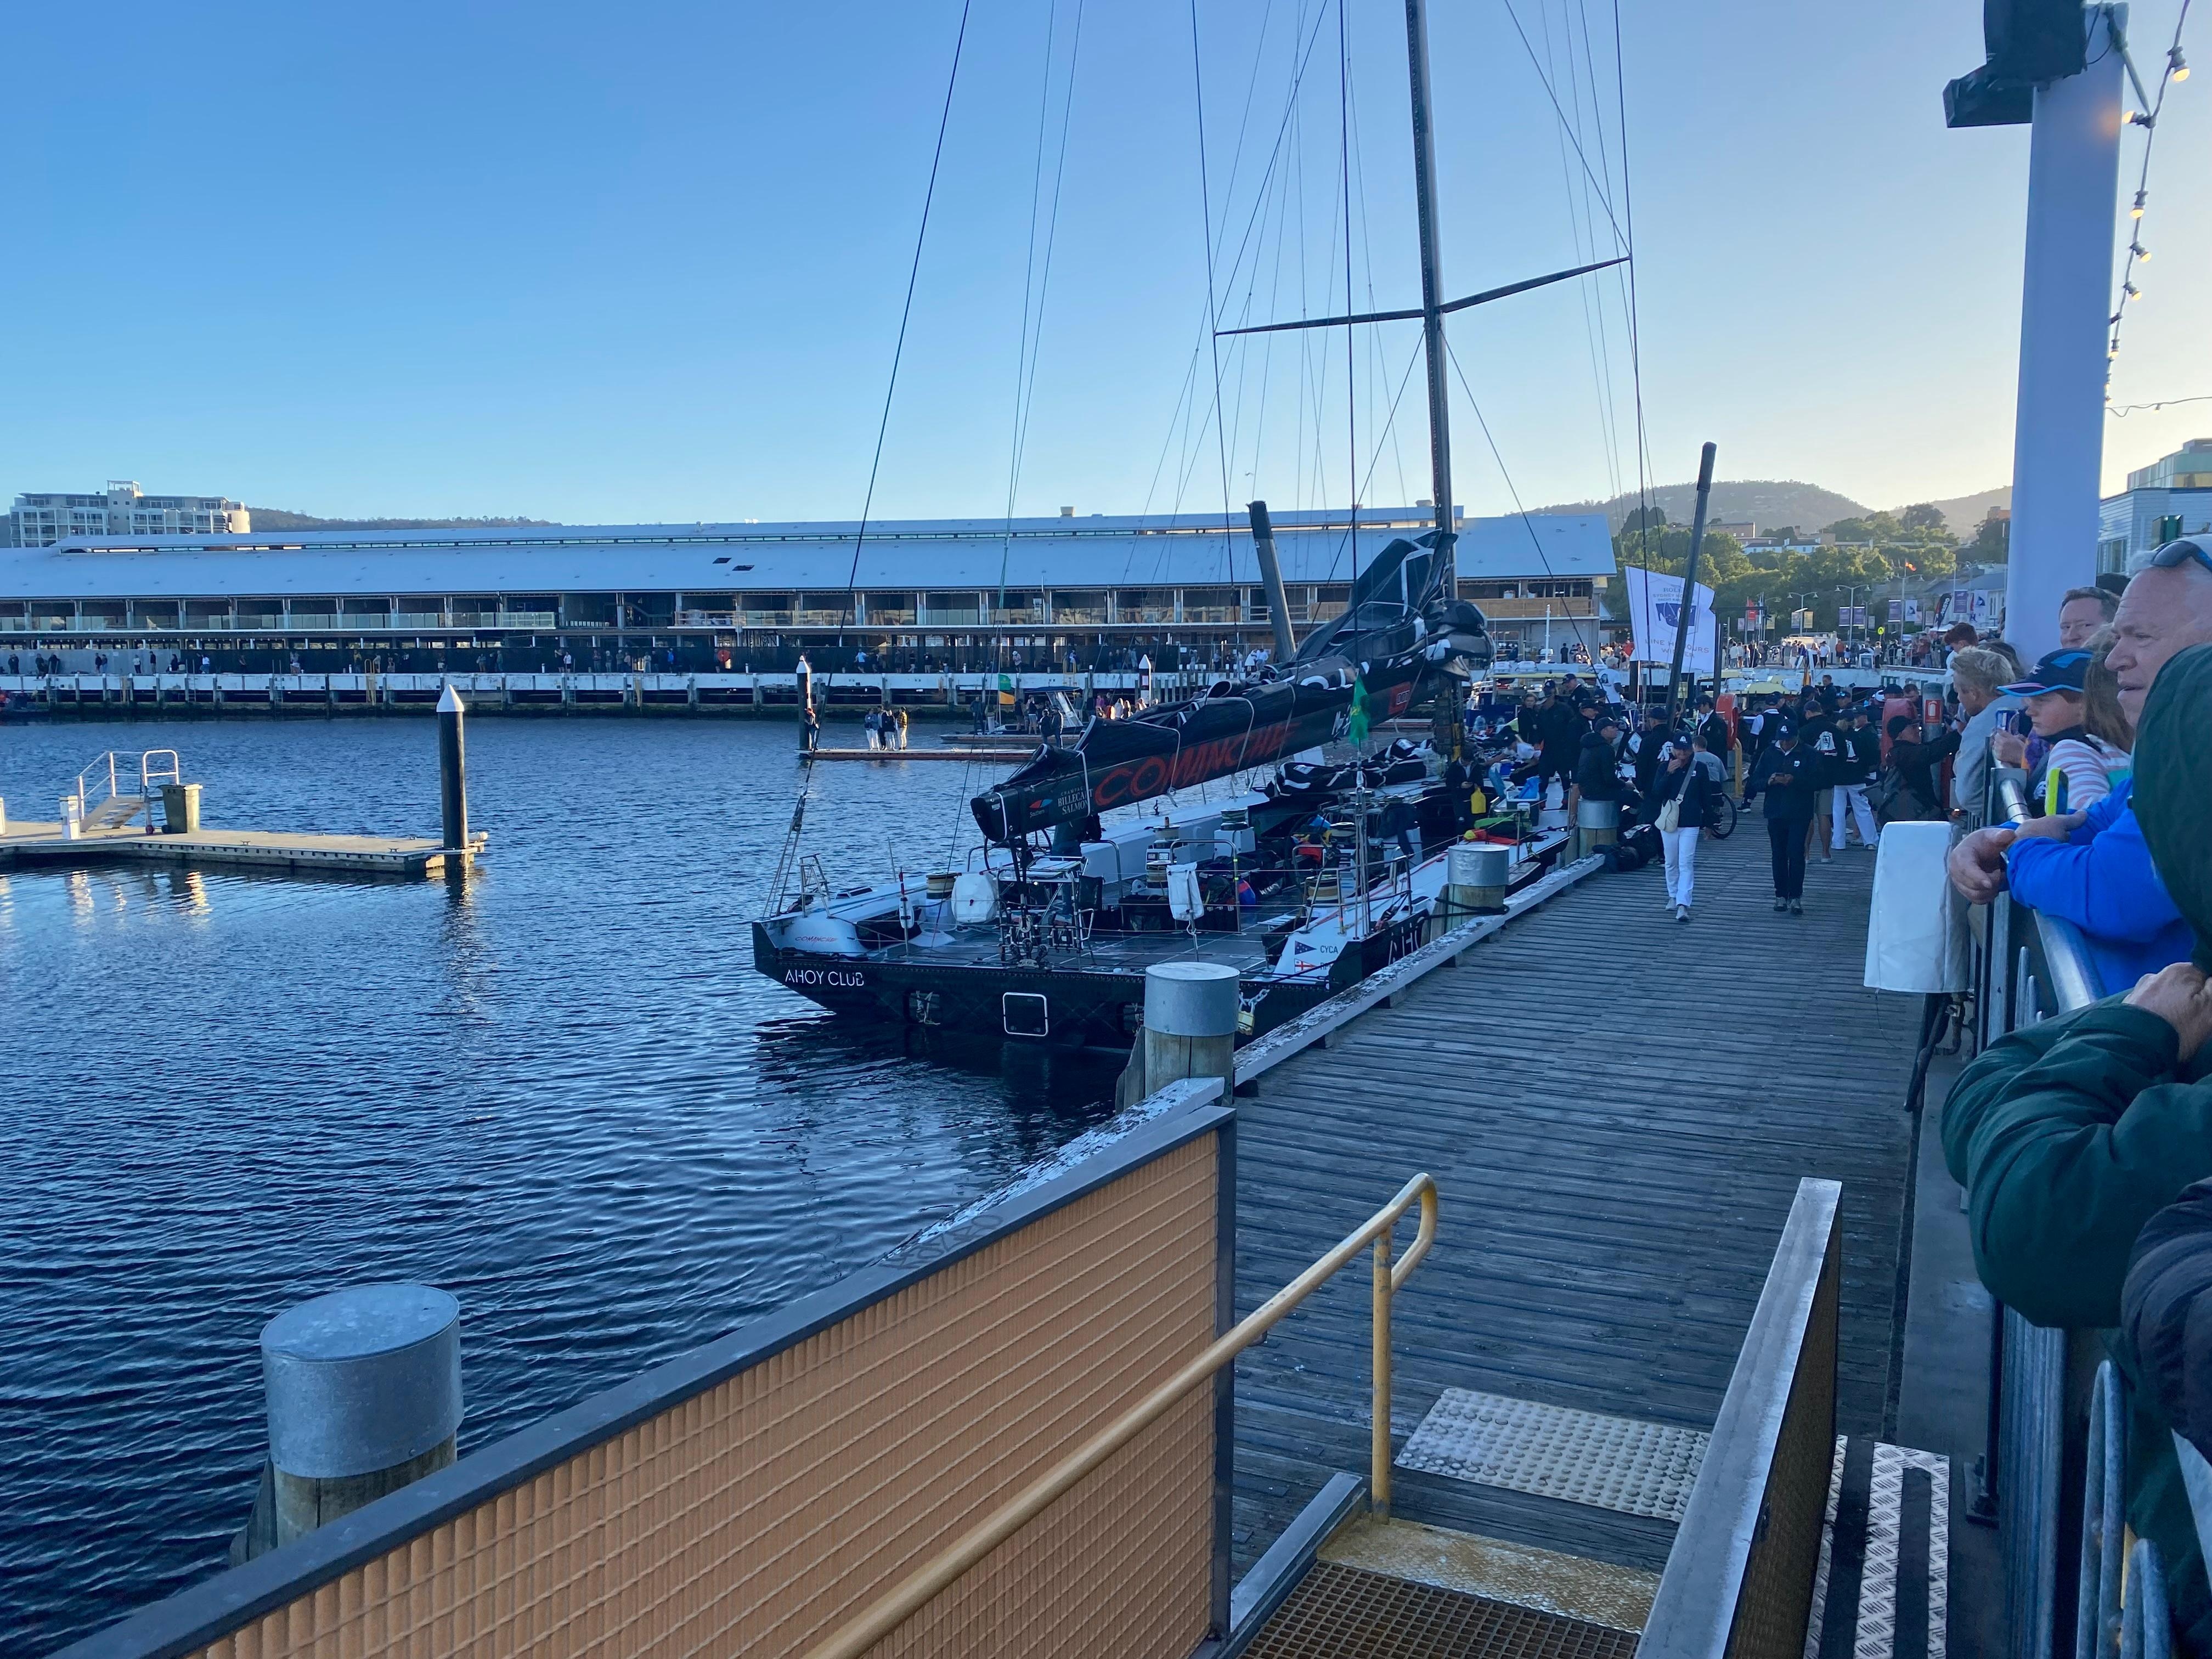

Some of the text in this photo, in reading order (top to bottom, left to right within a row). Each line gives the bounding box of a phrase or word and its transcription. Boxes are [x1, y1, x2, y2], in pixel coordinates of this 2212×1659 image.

[1662, 648, 1695, 658] WIER
[1668, 640, 1709, 653] HOURS
[1094, 721, 1302, 806] COMANCHE
[1320, 945, 1339, 954] CYCA
[785, 969, 865, 986] AHOY CLUB
